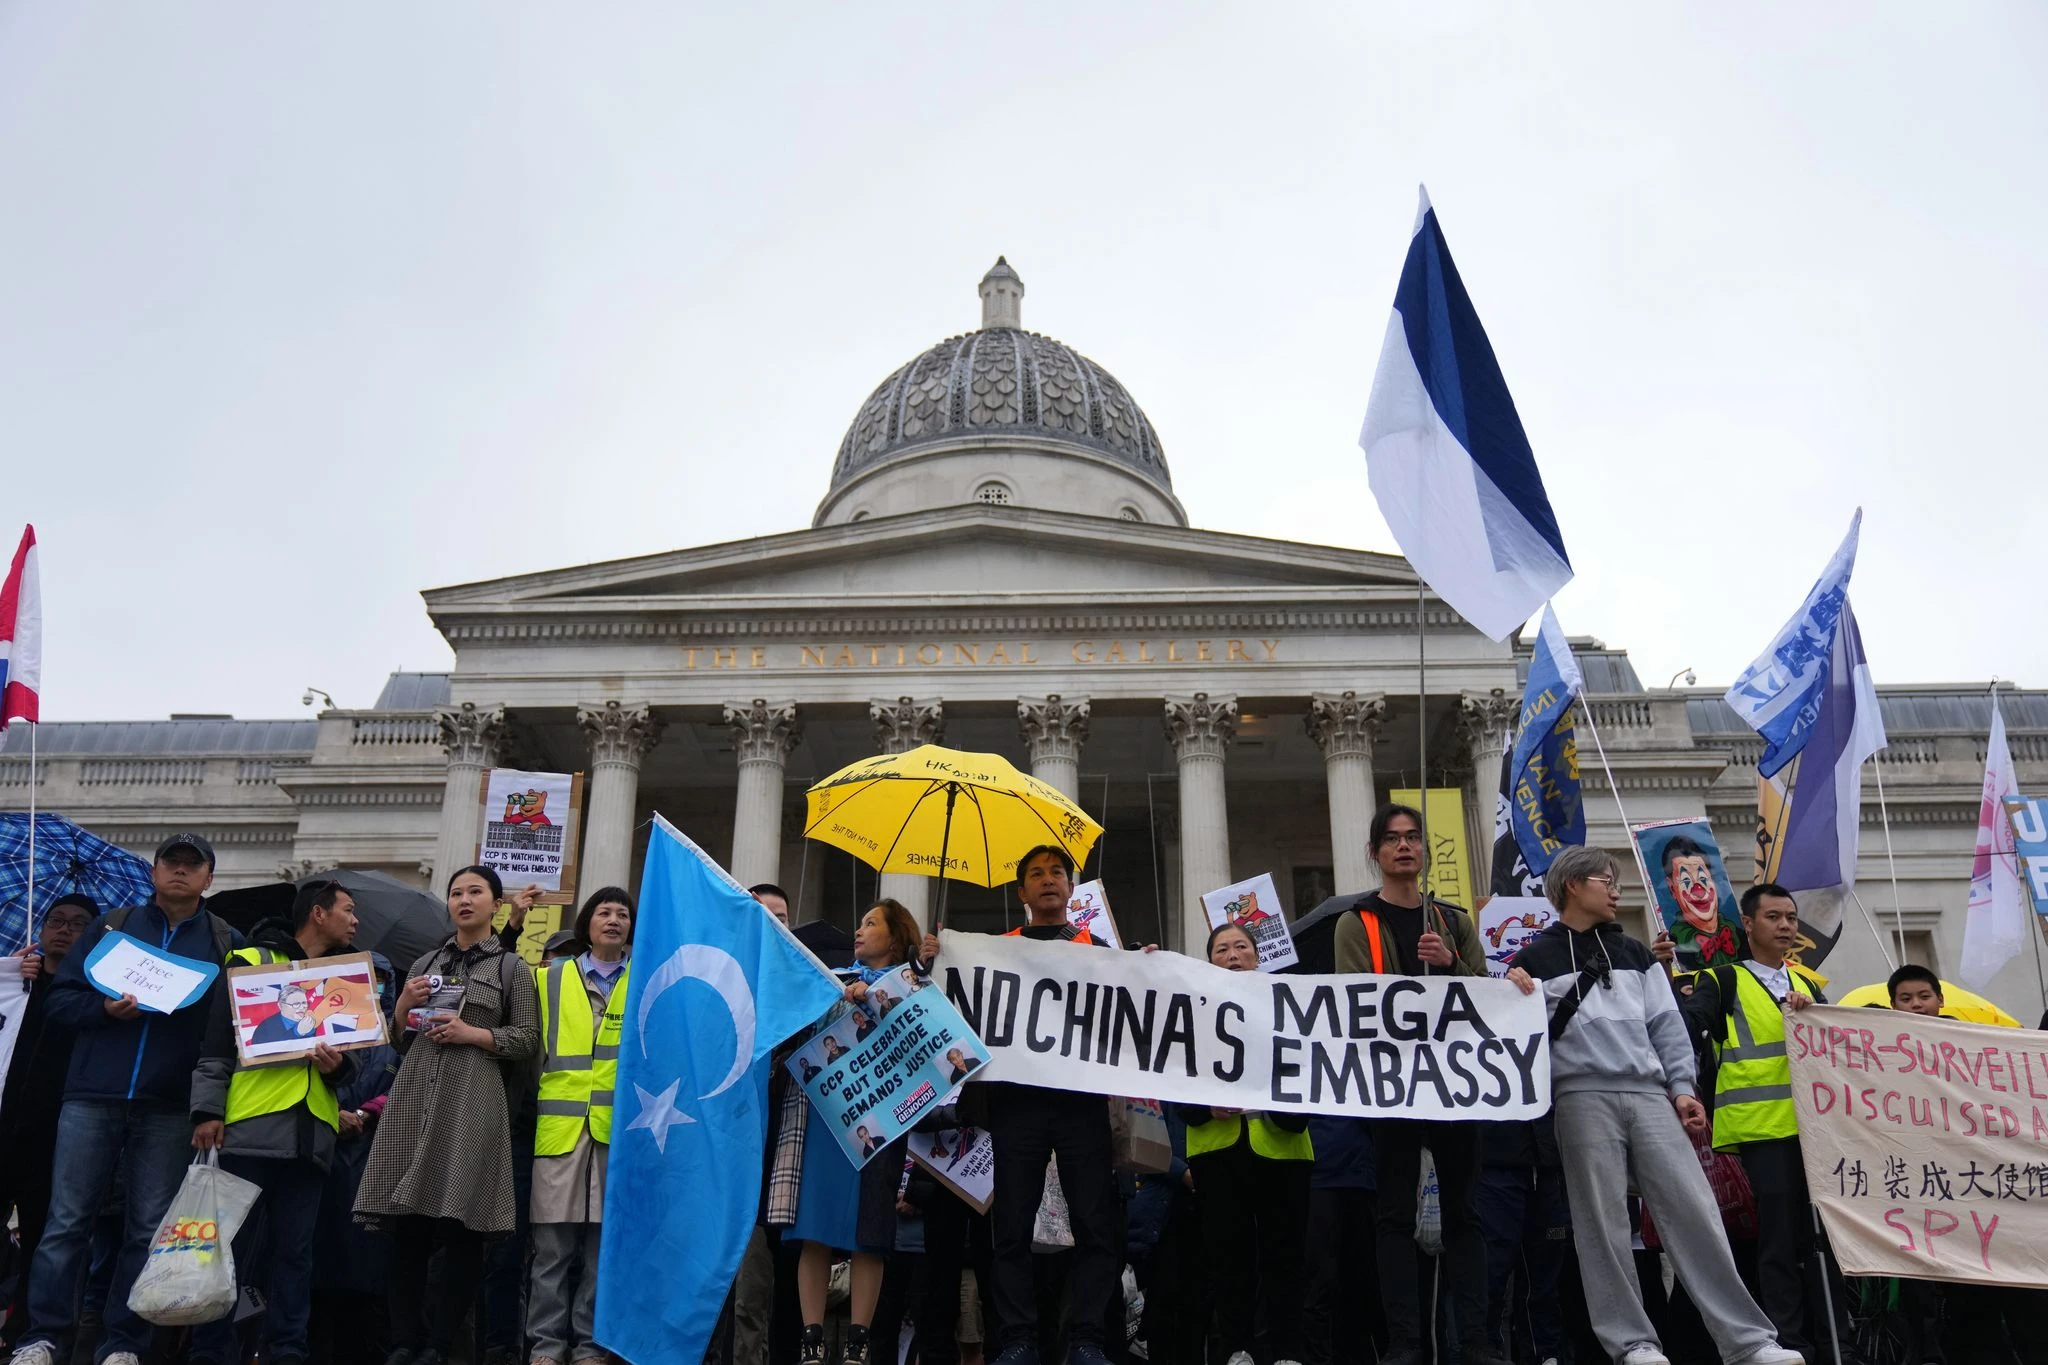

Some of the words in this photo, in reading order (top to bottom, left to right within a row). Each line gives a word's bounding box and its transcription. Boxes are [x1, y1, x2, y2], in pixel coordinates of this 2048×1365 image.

[681, 646, 767, 670] THE
[800, 642, 1039, 668] NATIONAL
[1071, 639, 1282, 664] GALLERY
[926, 760, 952, 772] HK
[1516, 778, 1562, 856] ENCE
[484, 851, 499, 859] CCP
[501, 852, 508, 860] IS
[511, 853, 544, 862] WATCHING
[547, 855, 560, 864] YOU
[499, 863, 510, 872] THE
[512, 864, 529, 873] MEGA
[531, 865, 560, 875] EMBASSY
[1435, 833, 1461, 900] LERY
[1257, 942, 1277, 954] CHING
[1278, 938, 1289, 947] YOU
[1268, 947, 1292, 960] EMBASSY
[123, 967, 164, 993] Tibet
[137, 957, 174, 979] Free
[946, 966, 1021, 1048] ND
[1026, 977, 1245, 1083] CHINA'S
[1271, 980, 1497, 1043] MEGA
[819, 1070, 845, 1097] CCP
[849, 1003, 929, 1074] CELEBRATES,
[842, 1074, 870, 1101] BUT
[874, 1022, 928, 1079] GENOCIDE
[840, 1074, 903, 1128] DEMANDS
[906, 1028, 953, 1077] JUSTICE
[1271, 1031, 1545, 1108] EMBASSY
[897, 1087, 936, 1123] GENOCIDE
[1811, 1081, 2020, 1138] DISGUISED
[960, 1163, 971, 1178] SAY
[969, 1154, 979, 1165] NO
[975, 1147, 984, 1155] TO
[969, 1146, 993, 1177] TRANSNAT
[159, 1220, 218, 1244] ESCO
[1883, 1207, 2000, 1272] SPY
